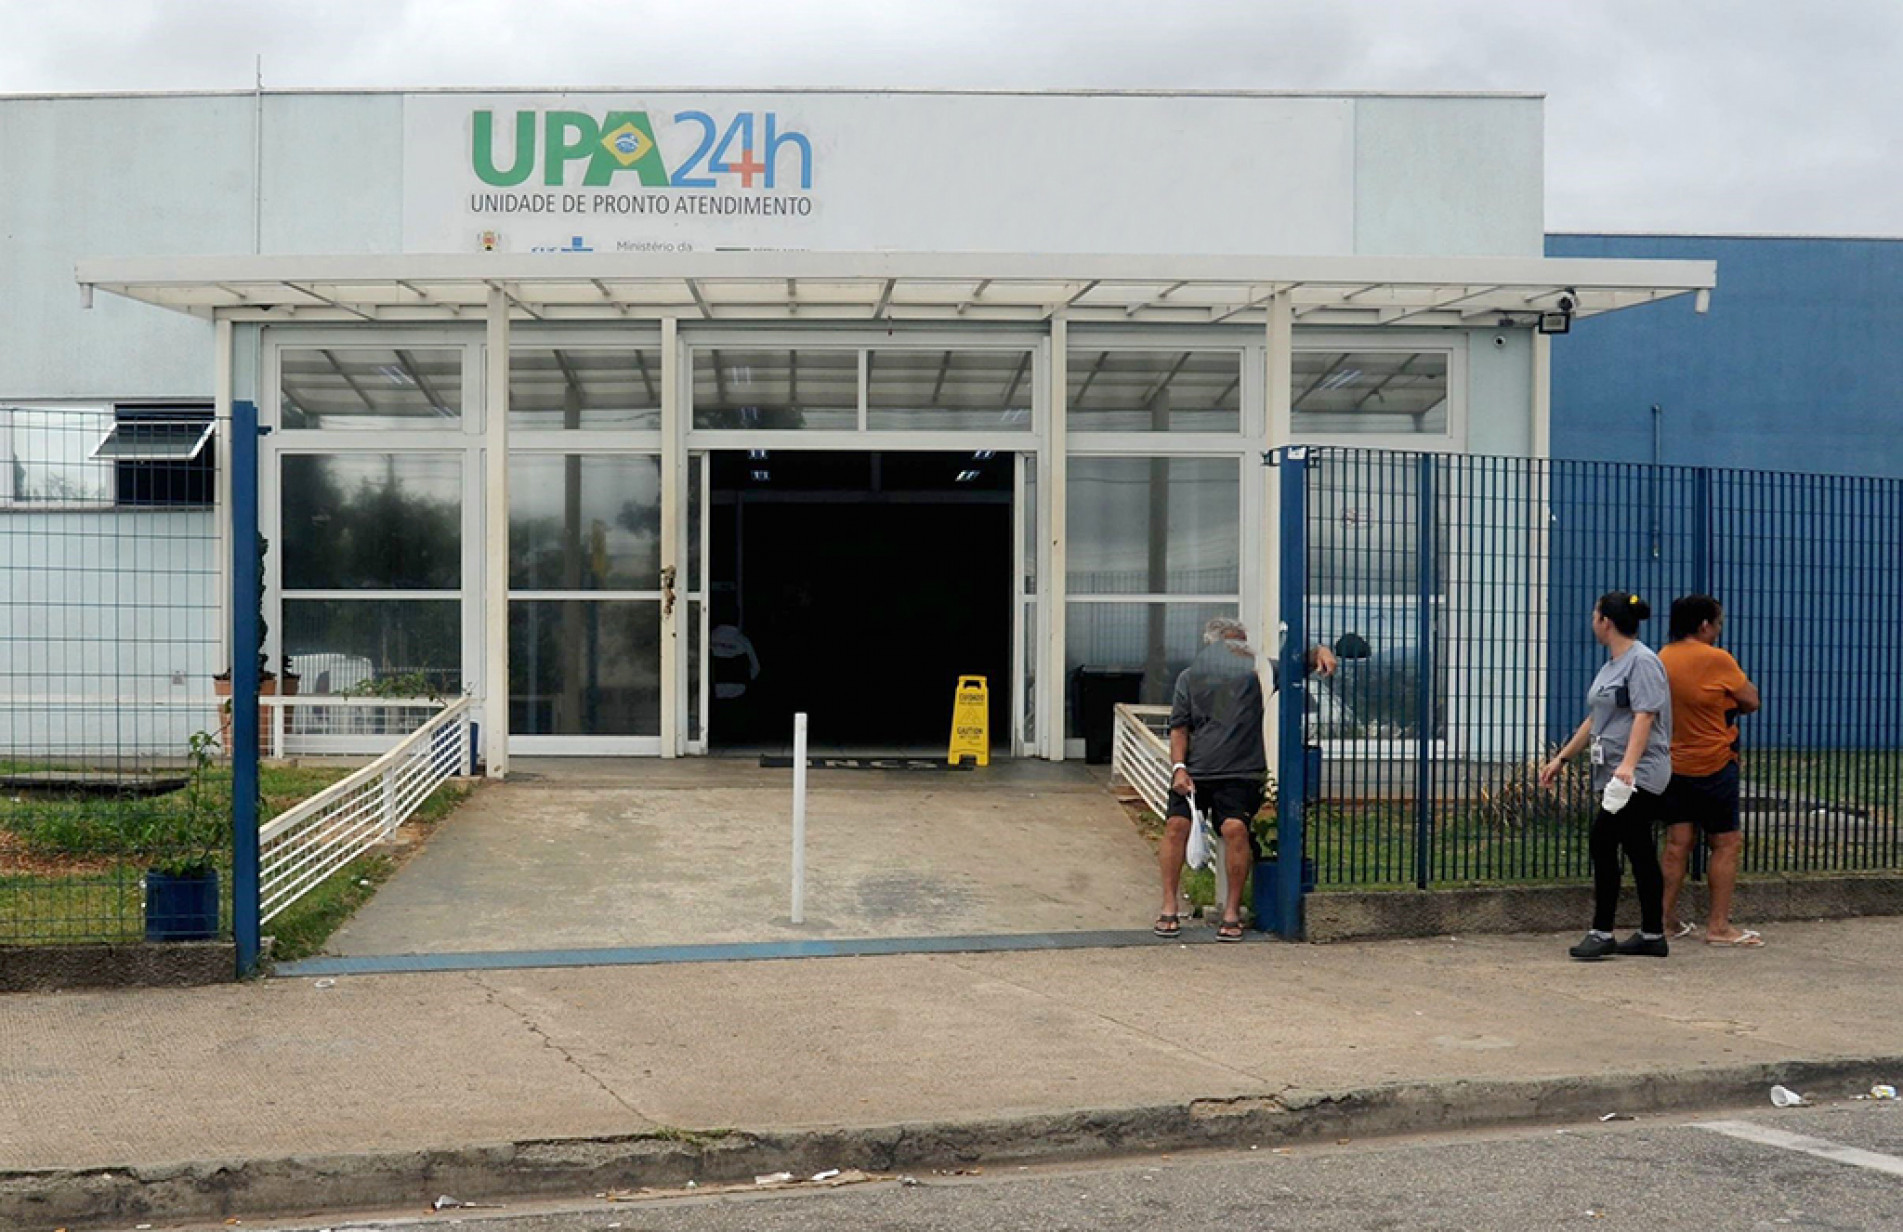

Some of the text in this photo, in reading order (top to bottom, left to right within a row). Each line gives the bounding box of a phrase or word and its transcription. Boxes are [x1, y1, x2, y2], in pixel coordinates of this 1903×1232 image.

[471, 194, 812, 216] UNIDADE DE PRONTO ATENDIMENTO
[616, 240, 693, 252] Ministério da
